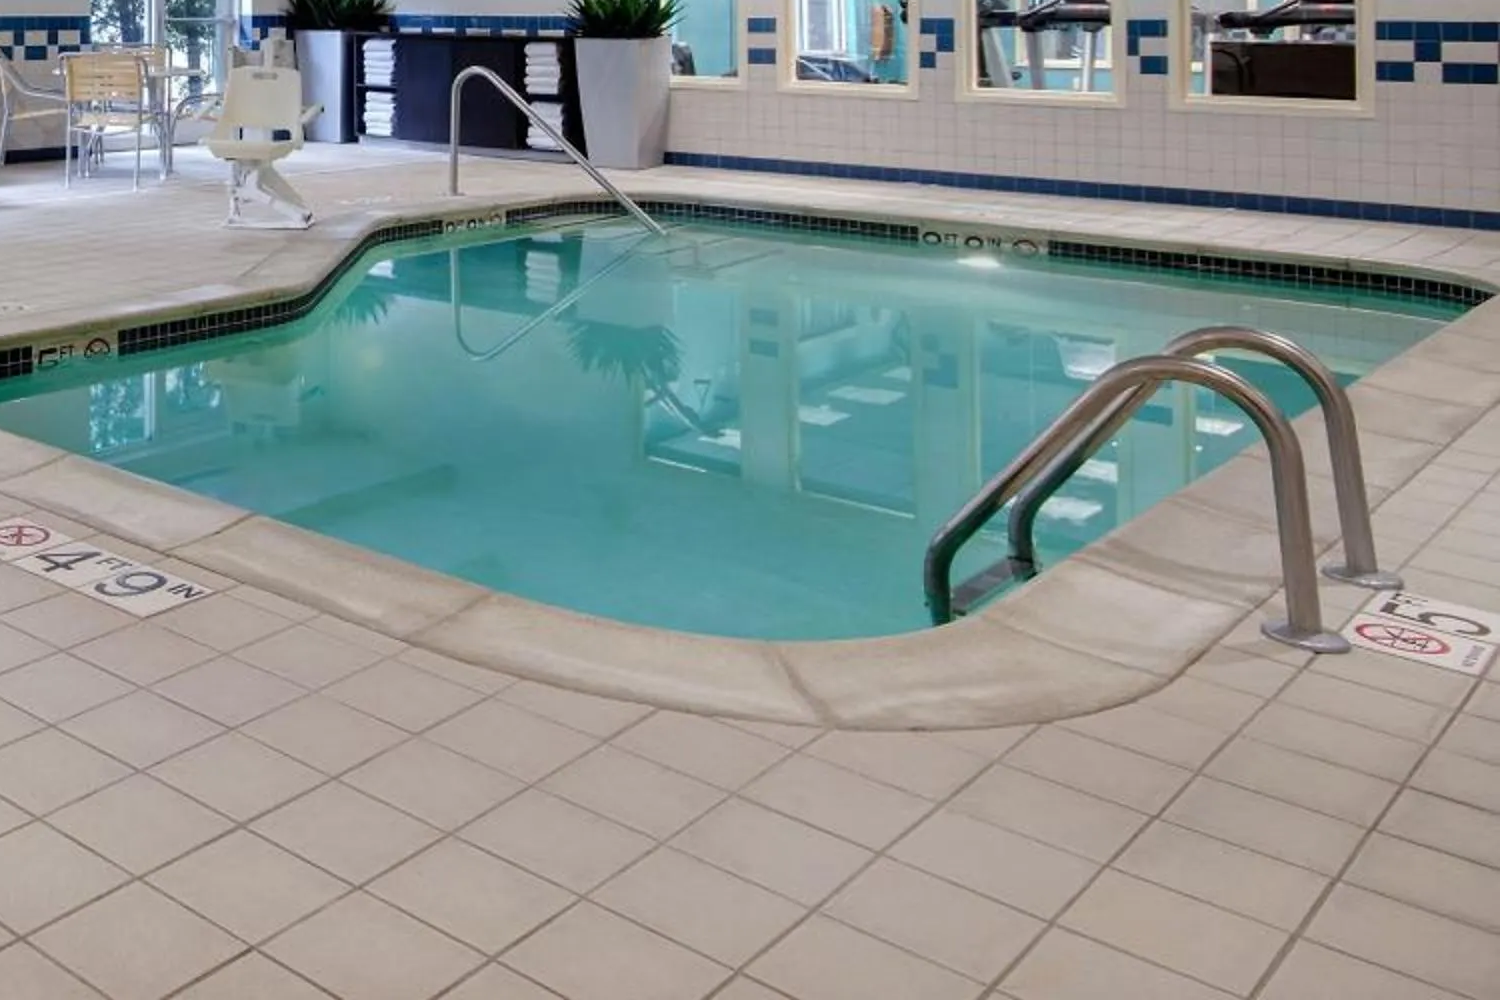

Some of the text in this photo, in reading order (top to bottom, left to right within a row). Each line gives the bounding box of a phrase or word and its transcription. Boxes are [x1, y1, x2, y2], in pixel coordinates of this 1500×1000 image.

[36, 551, 204, 599] 4 FT 9 IN
[1380, 601, 1492, 636] 5
